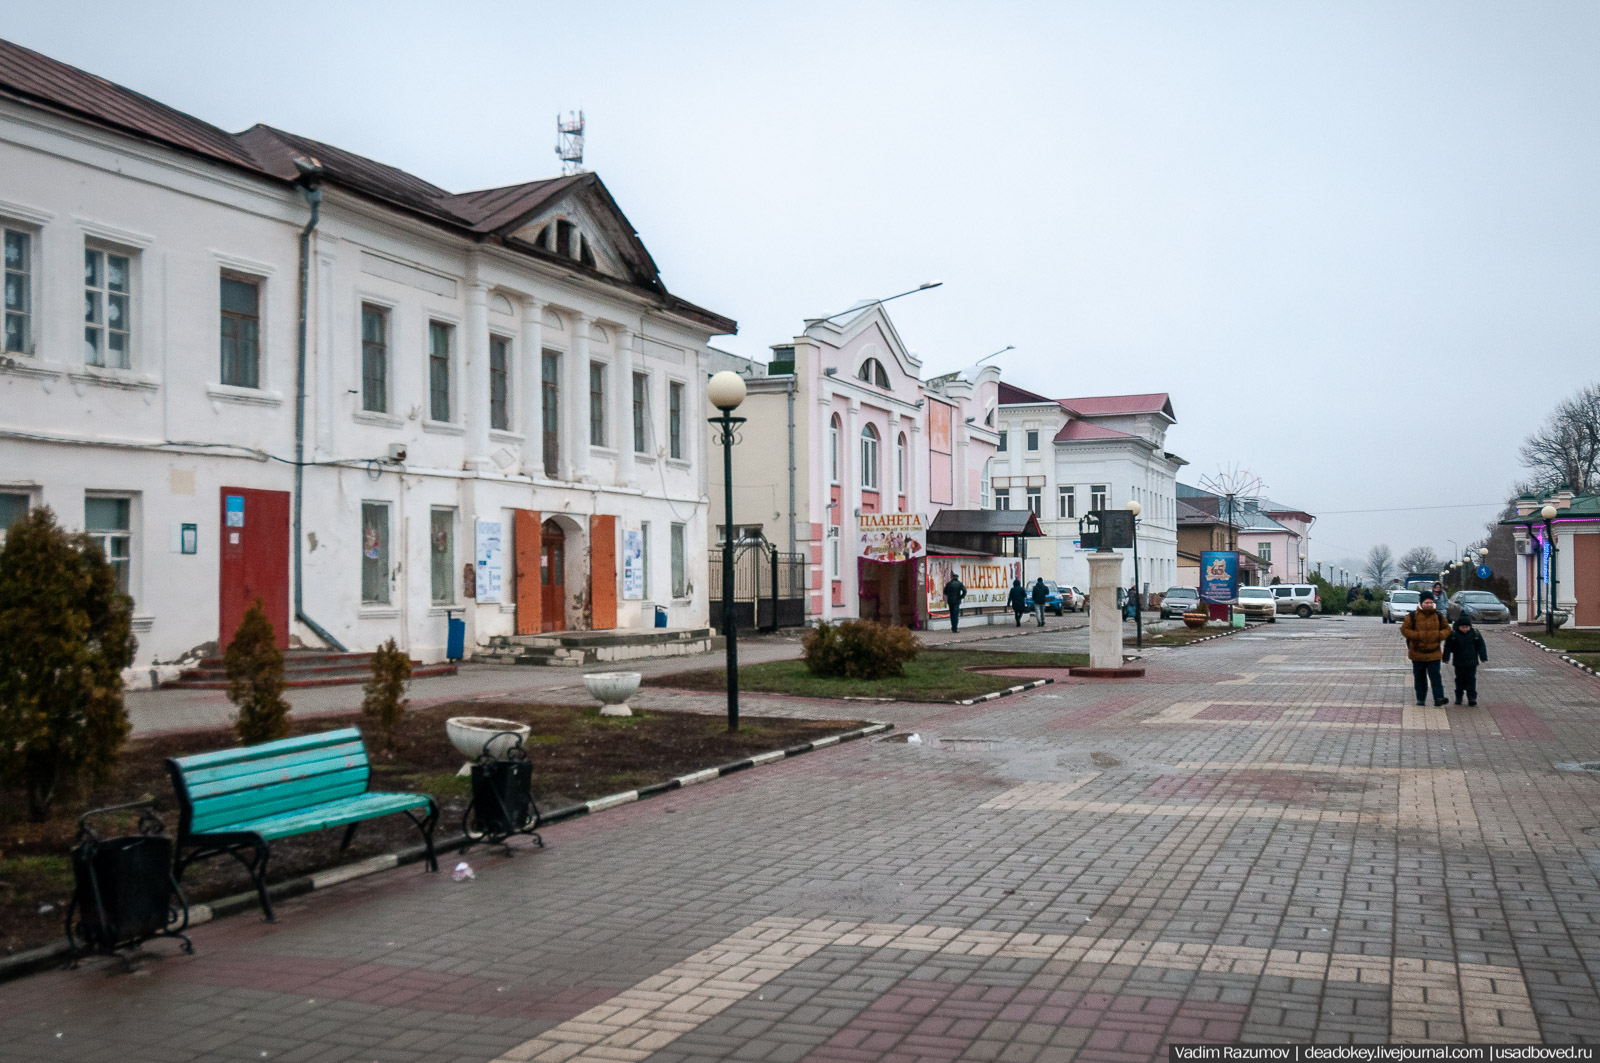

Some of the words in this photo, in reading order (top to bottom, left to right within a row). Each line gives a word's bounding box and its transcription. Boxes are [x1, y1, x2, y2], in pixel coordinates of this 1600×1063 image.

[860, 514, 921, 527] ПЛАНЕТА
[1211, 564, 1225, 576] 65
[960, 564, 1009, 590] ПЛАНЕТА
